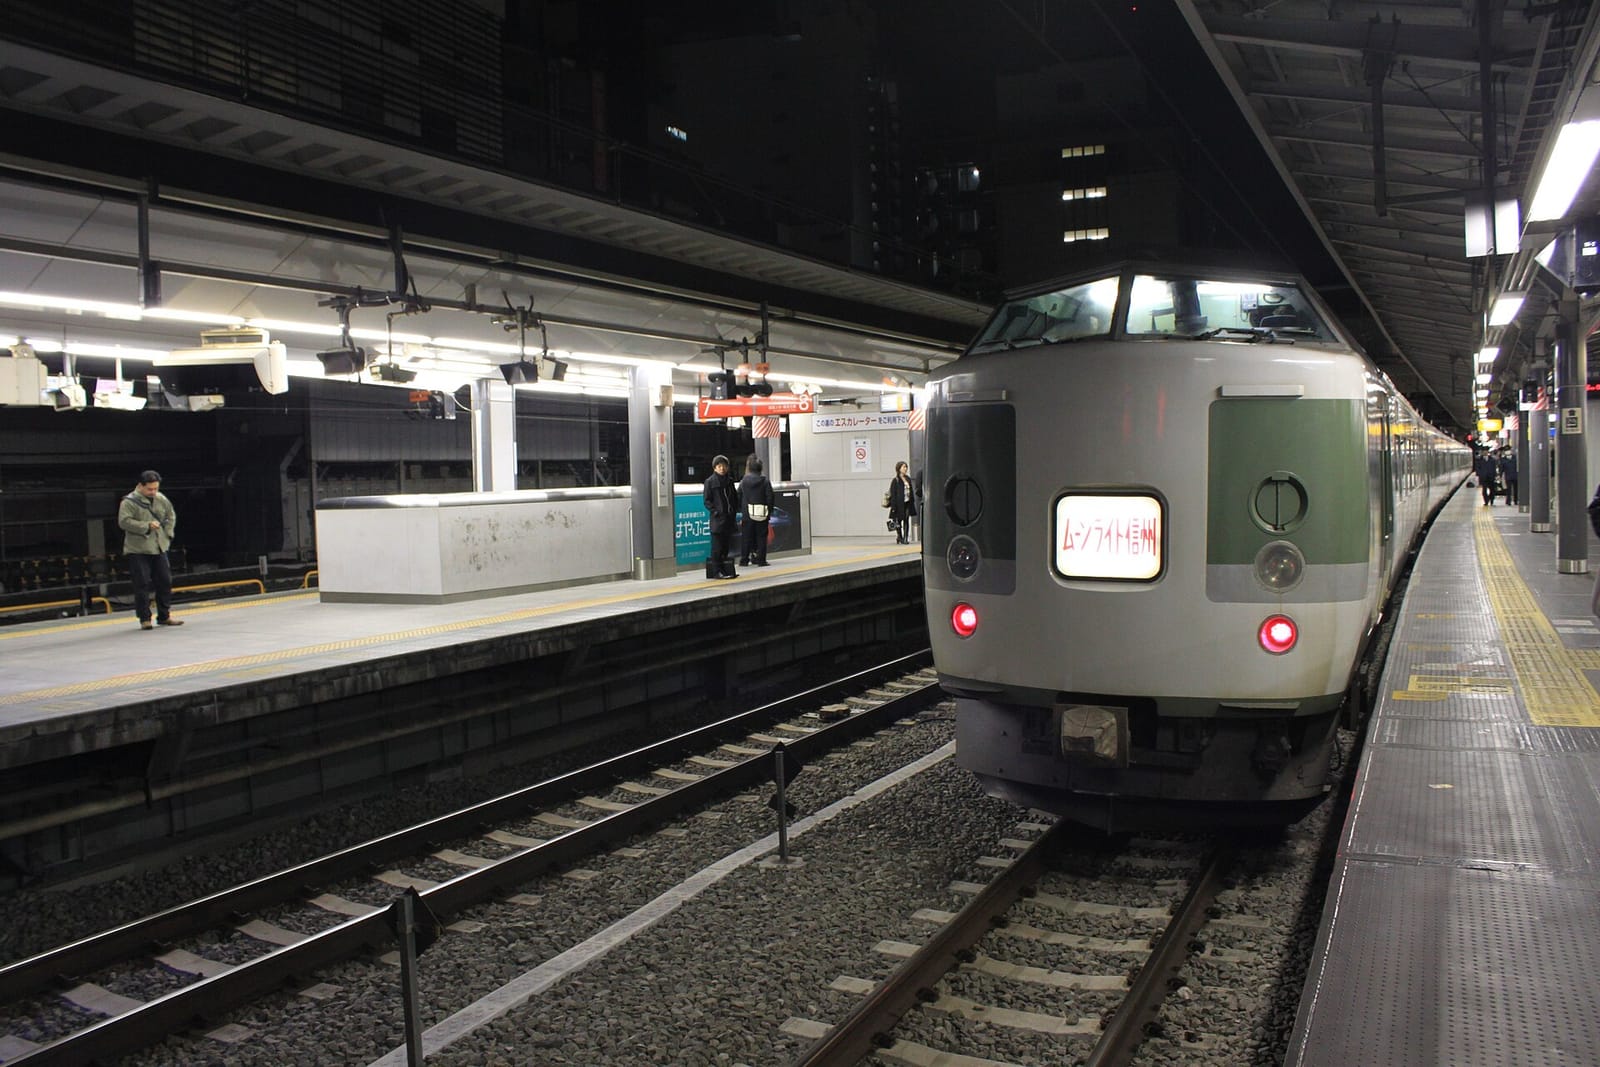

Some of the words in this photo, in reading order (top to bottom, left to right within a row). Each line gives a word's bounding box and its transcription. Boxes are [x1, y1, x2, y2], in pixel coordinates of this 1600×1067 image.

[701, 400, 712, 417] 7
[798, 394, 810, 411] 8
[1063, 517, 1157, 557] ムーンライト信州
